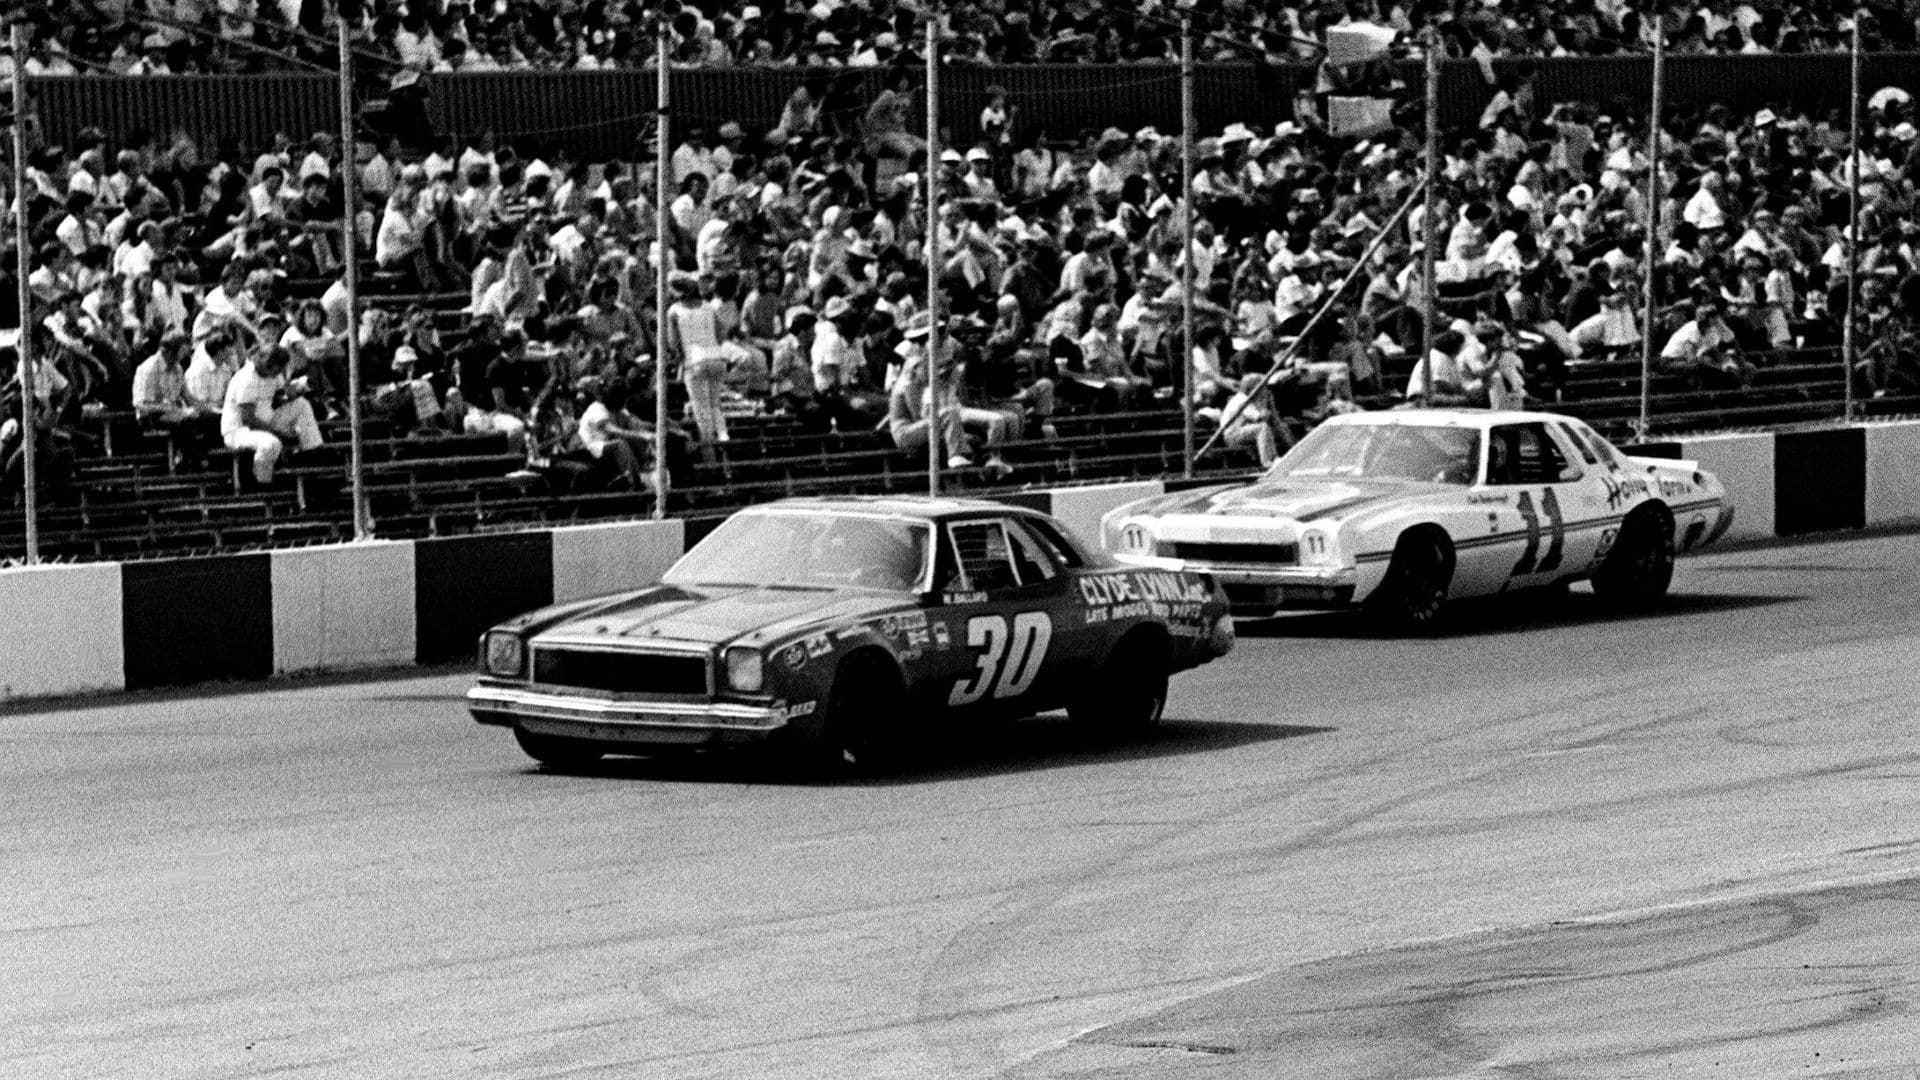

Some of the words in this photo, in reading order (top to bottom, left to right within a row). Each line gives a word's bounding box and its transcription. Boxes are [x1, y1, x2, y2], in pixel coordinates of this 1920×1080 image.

[1127, 529, 1143, 549] 11
[1307, 535, 1326, 554] 11
[1506, 486, 1565, 578] 11
[1079, 574, 1140, 605] CLYDE
[948, 611, 1052, 706] 30
